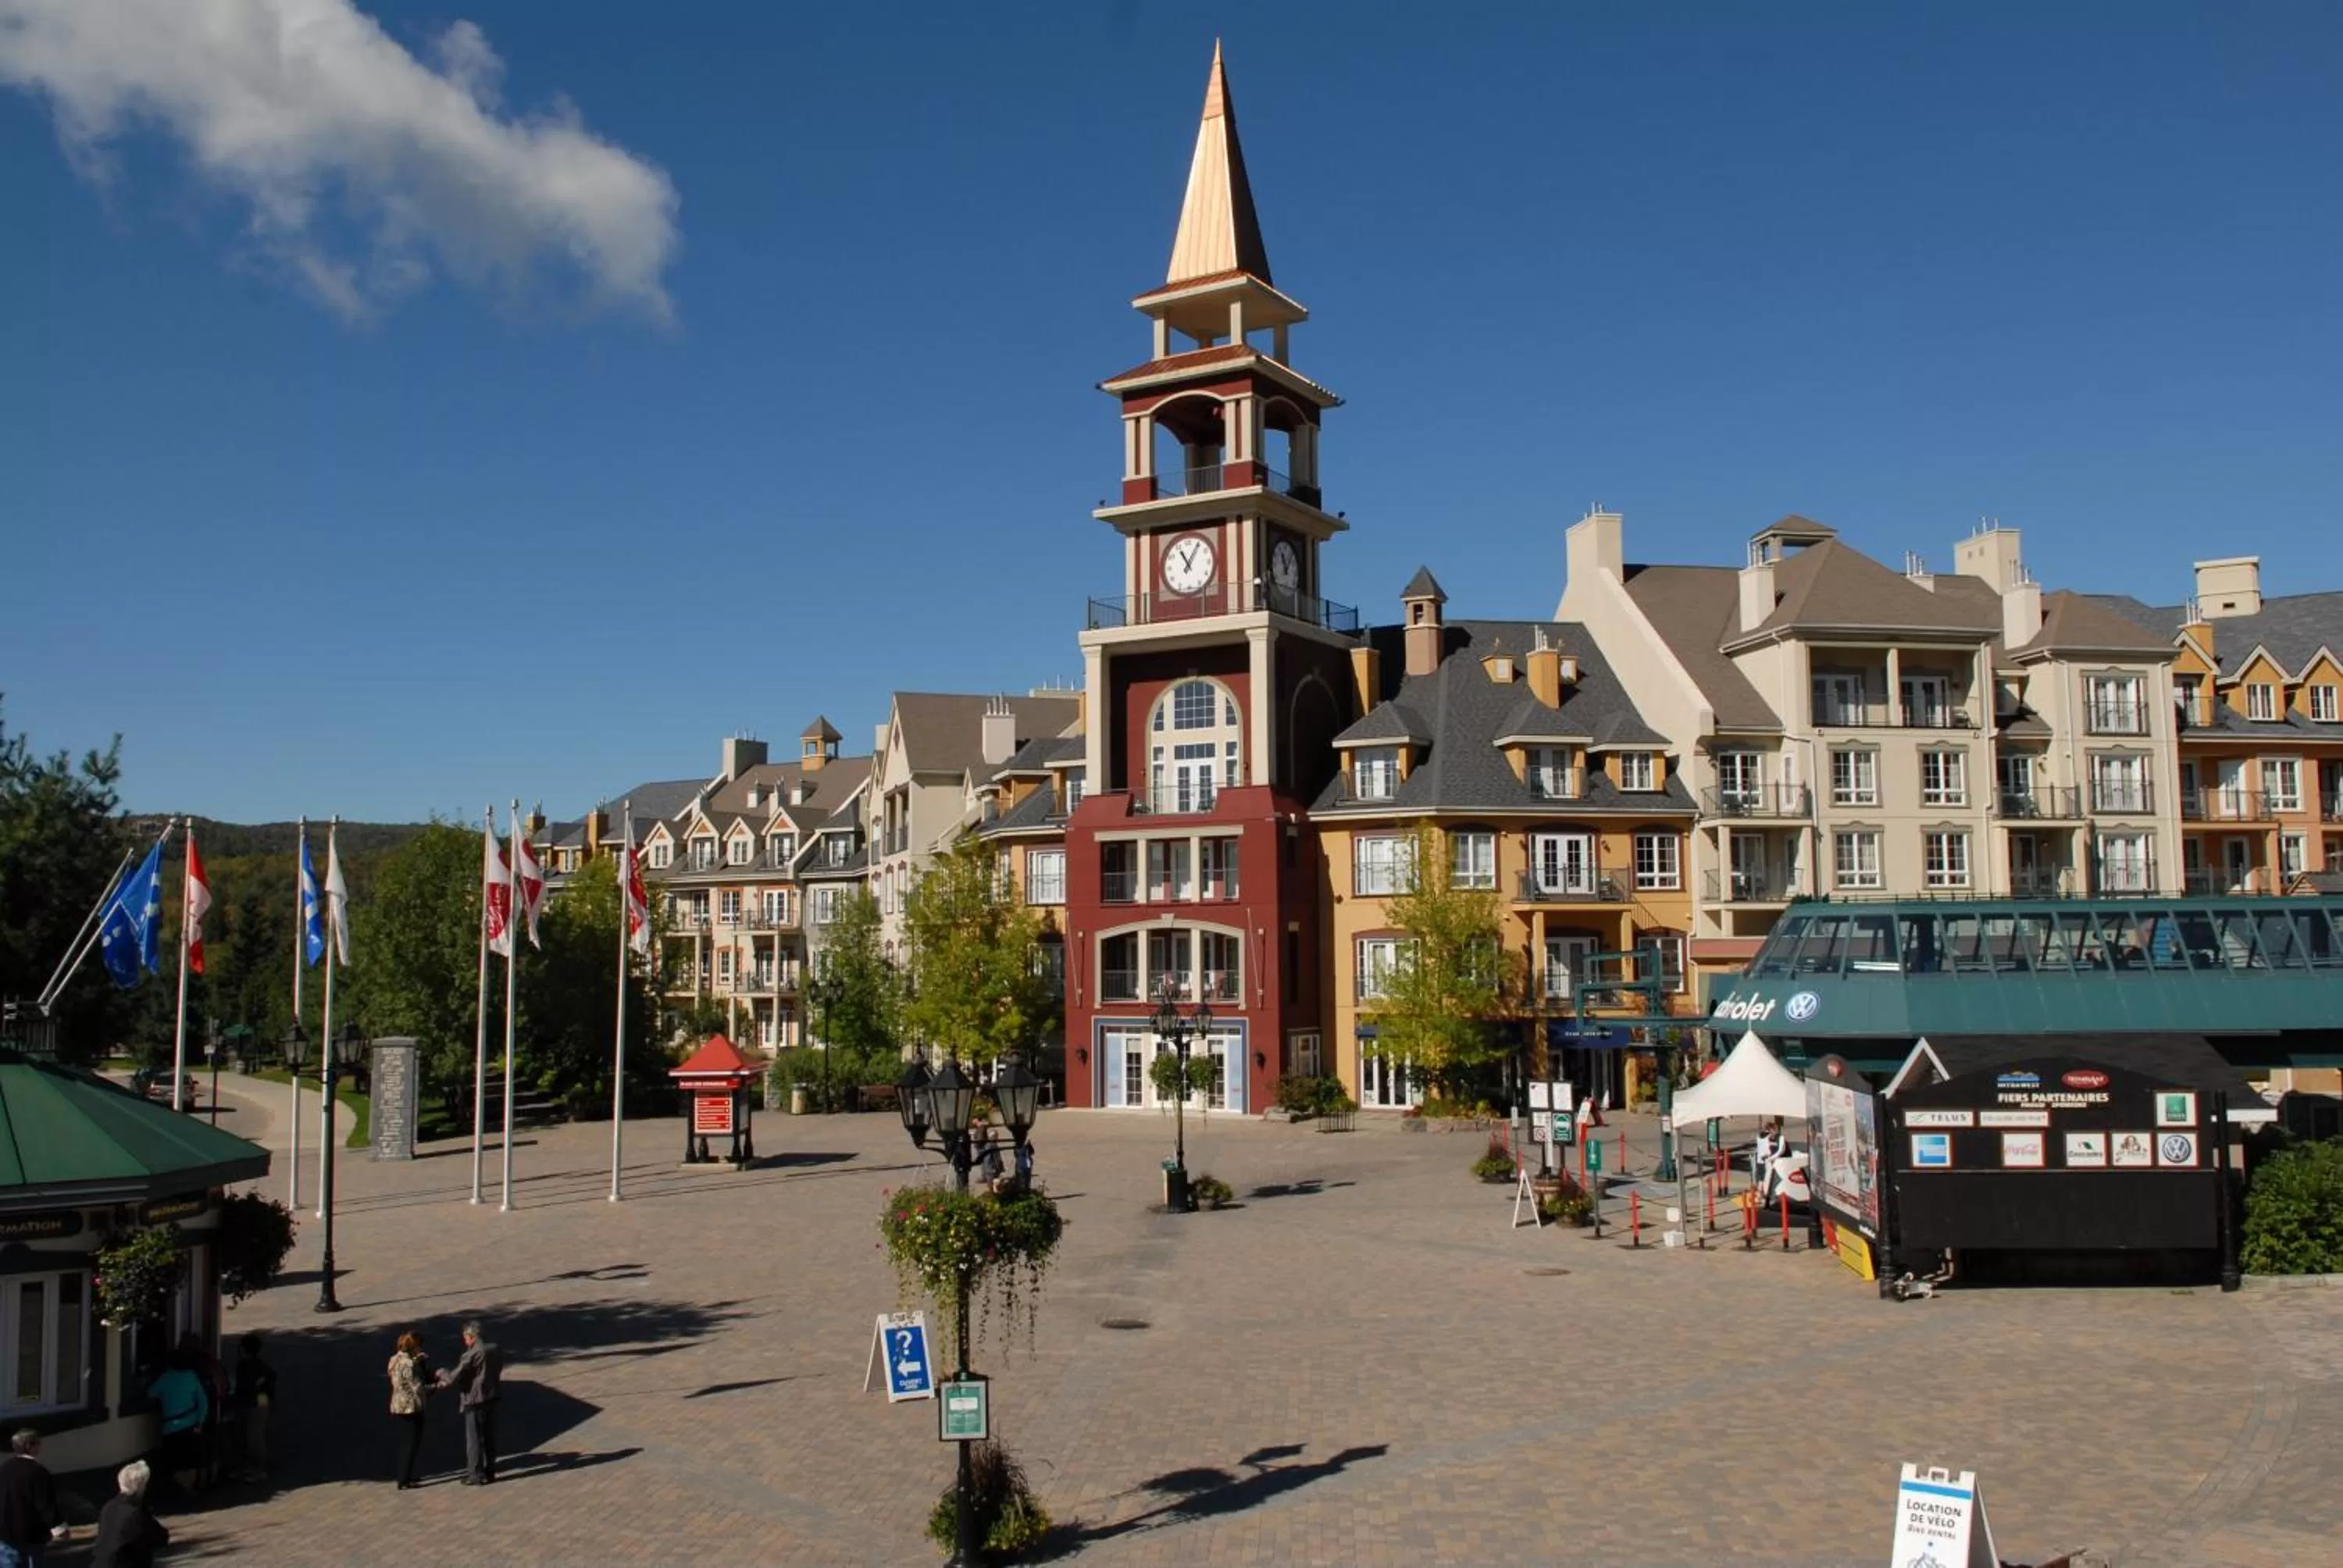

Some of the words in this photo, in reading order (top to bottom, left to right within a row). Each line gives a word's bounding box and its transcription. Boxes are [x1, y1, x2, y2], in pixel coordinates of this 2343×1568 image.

[1997, 1093, 2029, 1103] FIERS
[2031, 1092, 2109, 1102] PARTENAIRES
[1931, 1114, 1967, 1122] TELUS
[1906, 1499, 1962, 1516] LOCATION
[1910, 1513, 1924, 1523] DE
[1927, 1515, 1955, 1528] VÉLO
